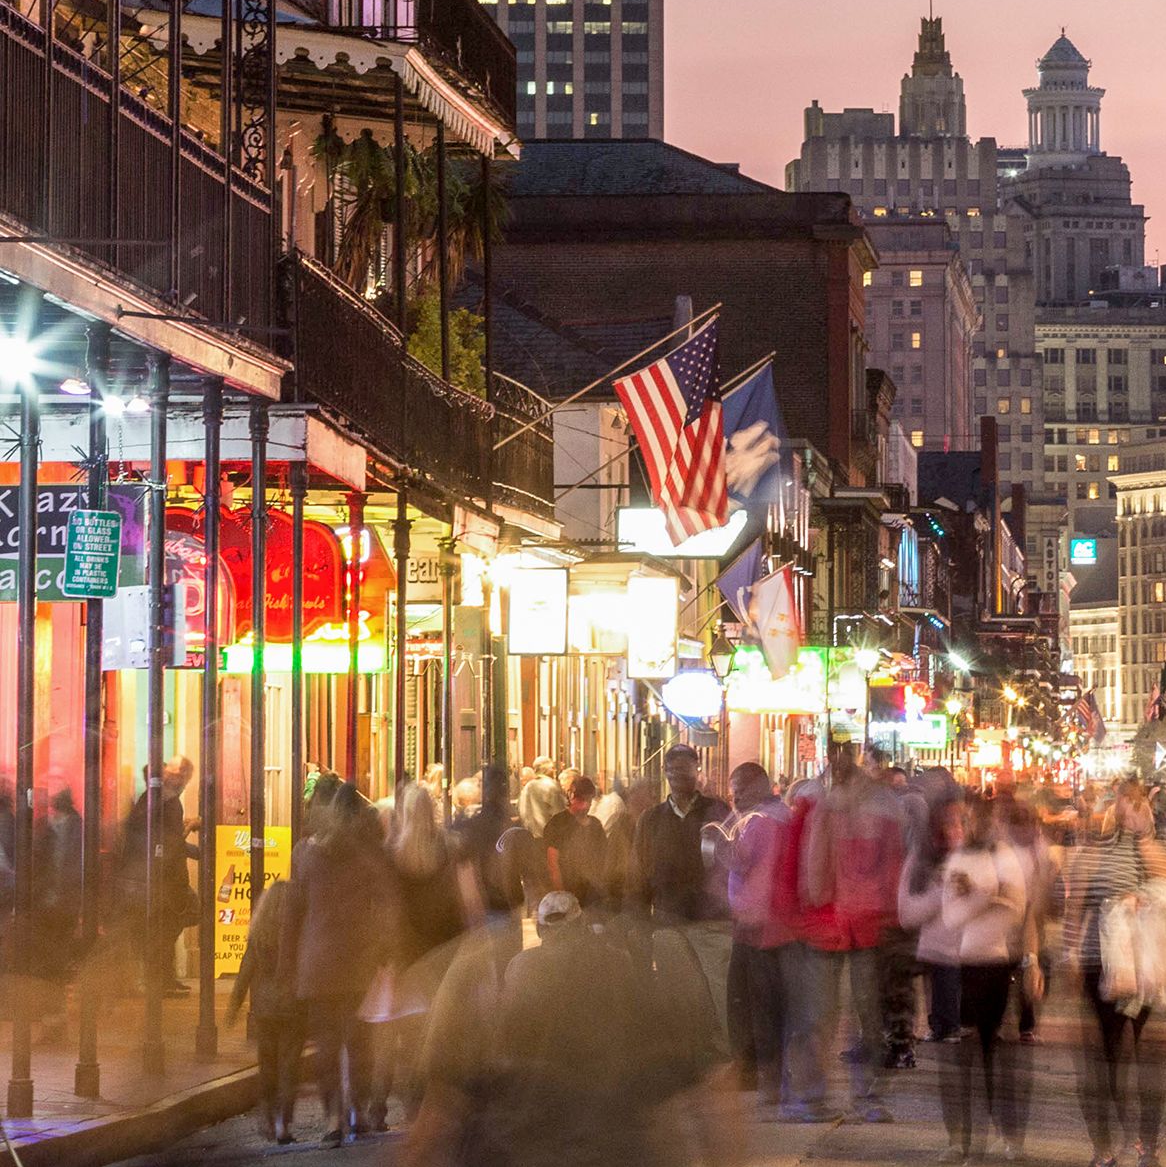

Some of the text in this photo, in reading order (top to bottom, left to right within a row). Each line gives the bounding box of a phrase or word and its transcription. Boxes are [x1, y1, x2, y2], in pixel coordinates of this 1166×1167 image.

[88, 527, 112, 535] GLASS
[77, 535, 110, 543] ALLOWED
[85, 543, 112, 552] STREET
[1046, 539, 1054, 591] ASTOR
[232, 872, 281, 884] HAPY
[222, 934, 240, 942] BEER
[229, 943, 244, 951] YOU
